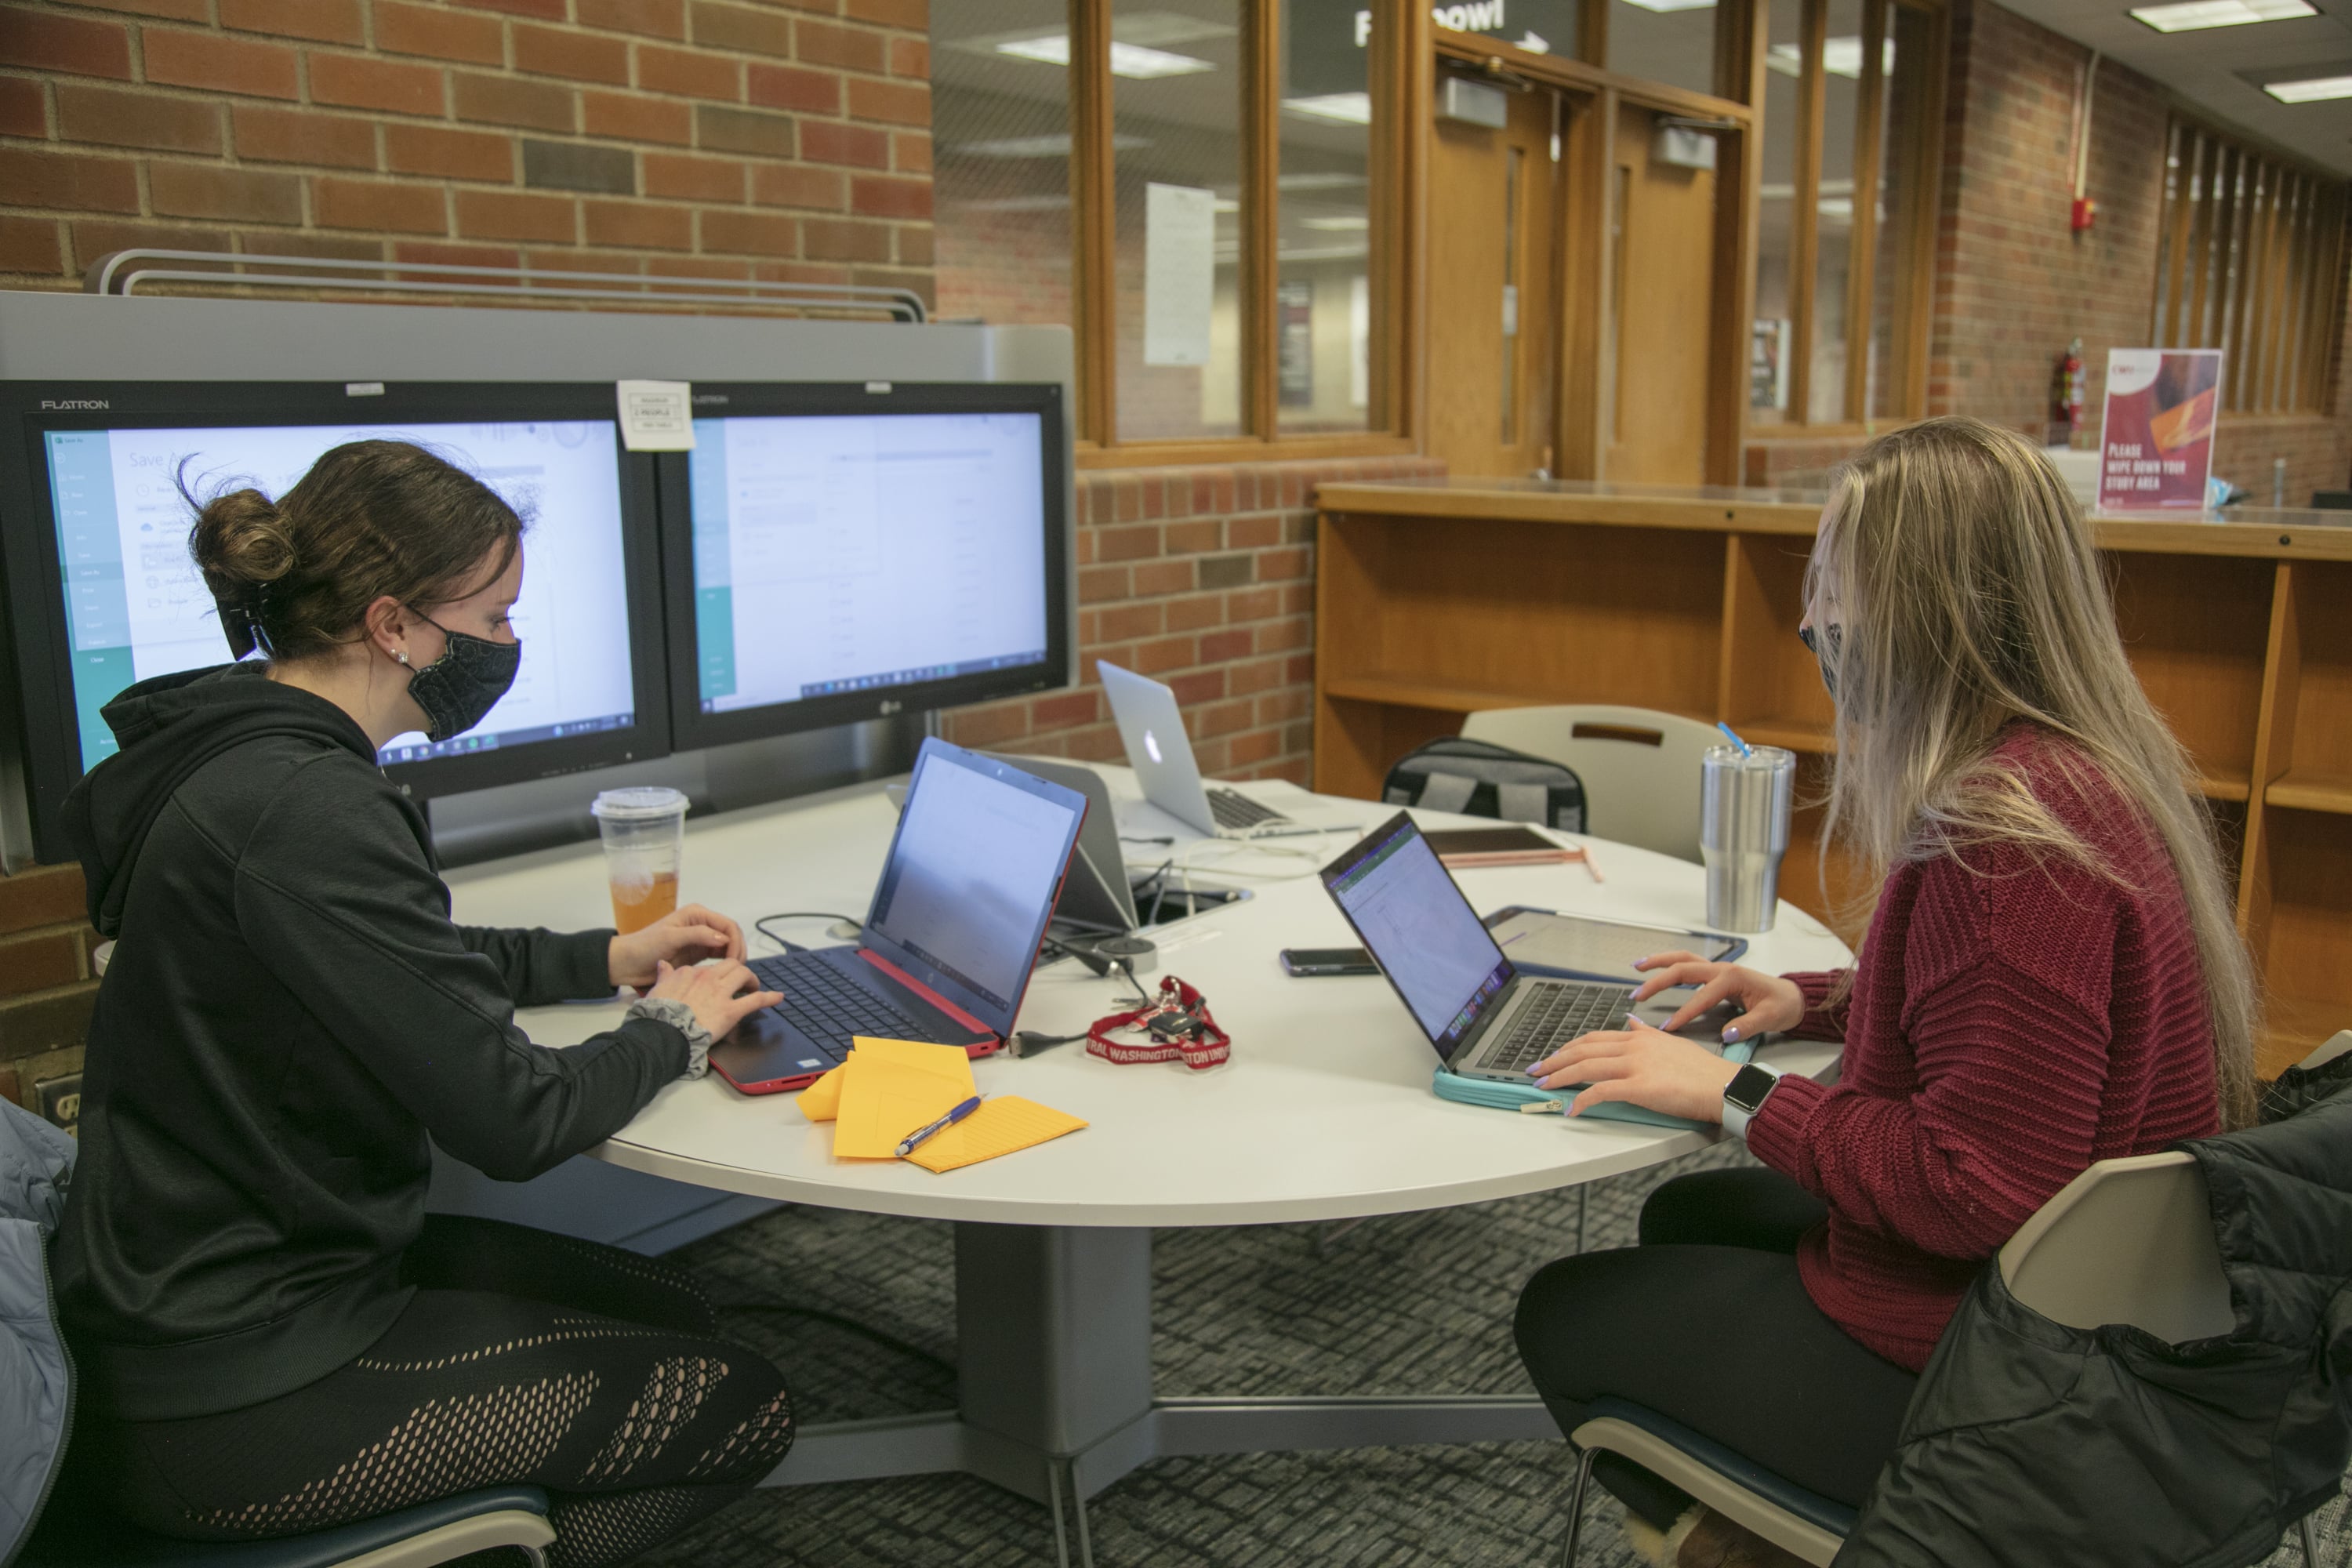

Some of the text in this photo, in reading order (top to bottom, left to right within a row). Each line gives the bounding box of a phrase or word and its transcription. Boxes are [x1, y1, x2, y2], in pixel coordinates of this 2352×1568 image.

[42, 400, 110, 410] FLATRON
[2107, 459, 2187, 475] WIPE DOWN YOUR
[2104, 475, 2161, 491] STUDY AREA
